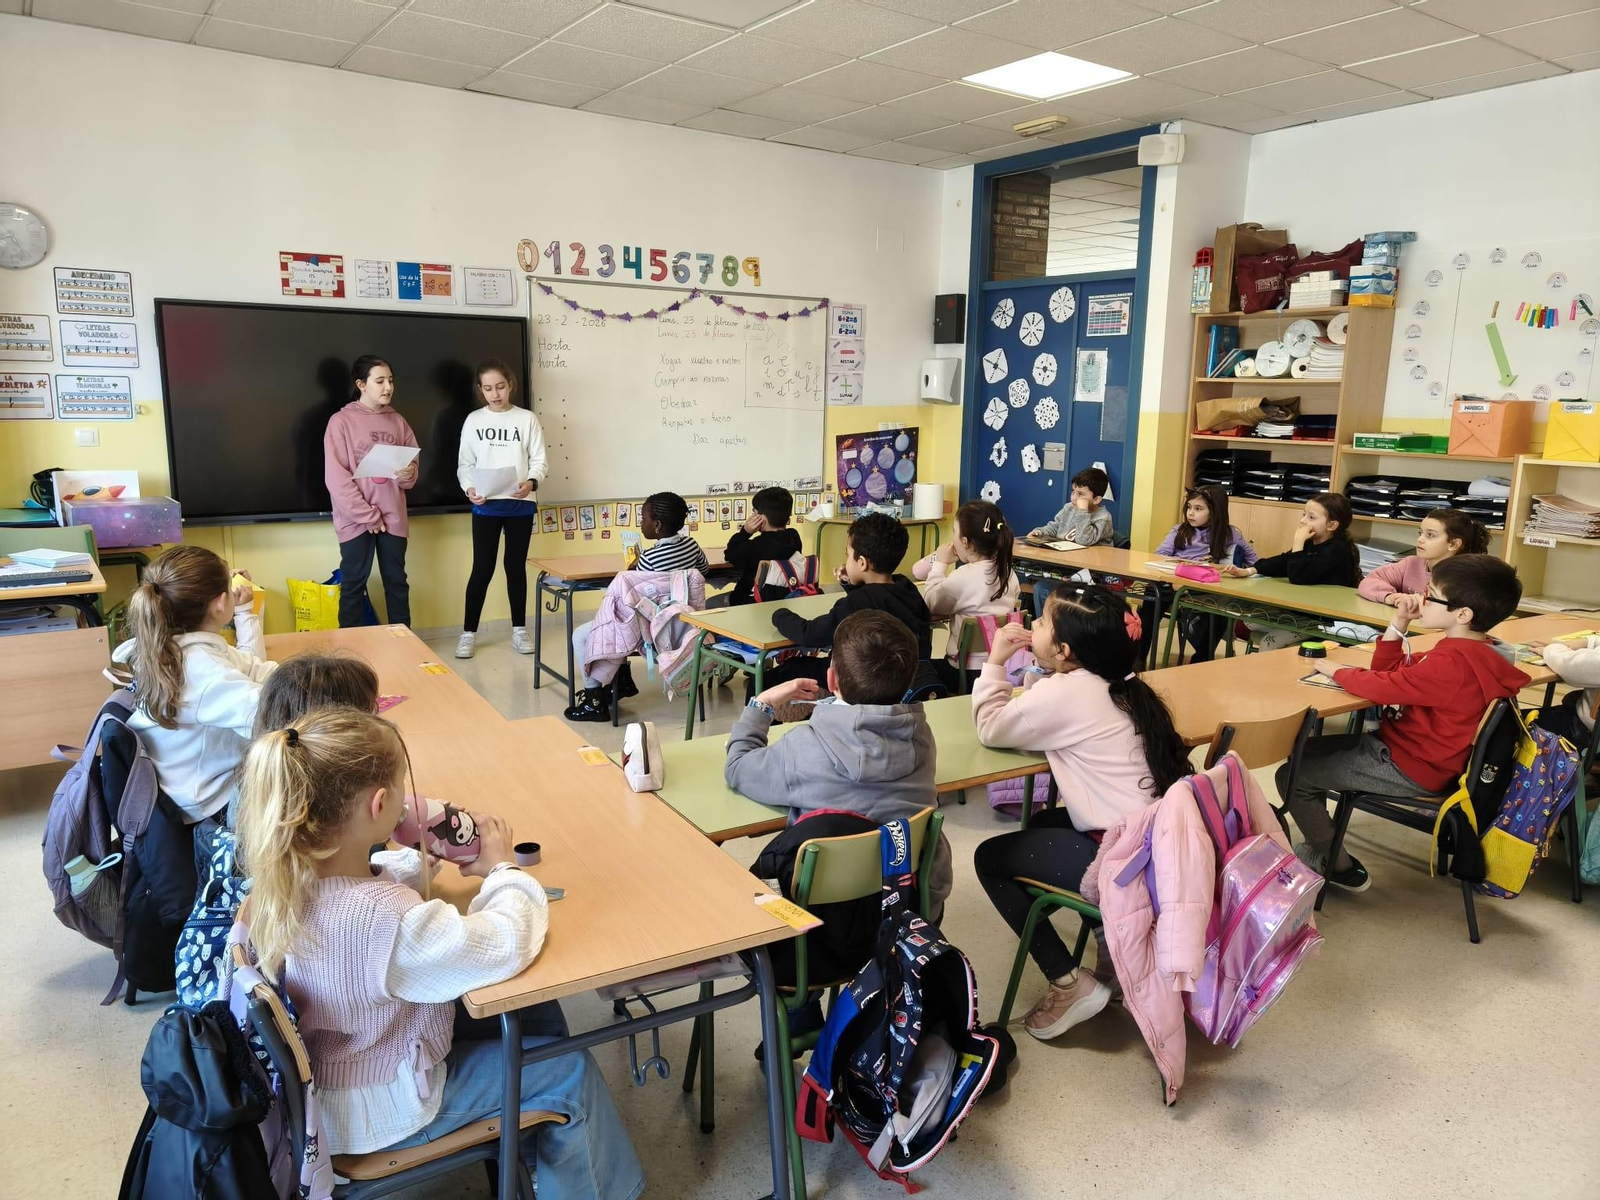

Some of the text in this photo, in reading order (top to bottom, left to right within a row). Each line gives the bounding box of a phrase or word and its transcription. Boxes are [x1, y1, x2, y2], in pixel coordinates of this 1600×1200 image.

[518, 239, 760, 286] 0 1 2 3 4 5 6 7 8 9
[72, 271, 116, 280] ABECEDARIO
[538, 314, 550, 324] 23
[683, 316, 694, 324] 23
[704, 315, 711, 325] de
[686, 330, 696, 338] 23
[538, 337, 571, 350] Horta
[538, 352, 568, 368] horta
[763, 356, 774, 365] a
[779, 356, 791, 367] e
[777, 369, 790, 377] o
[777, 386, 786, 397] d
[476, 426, 520, 441] VOILÀ
[692, 434, 709, 445] Dar
[734, 482, 742, 491] 20
